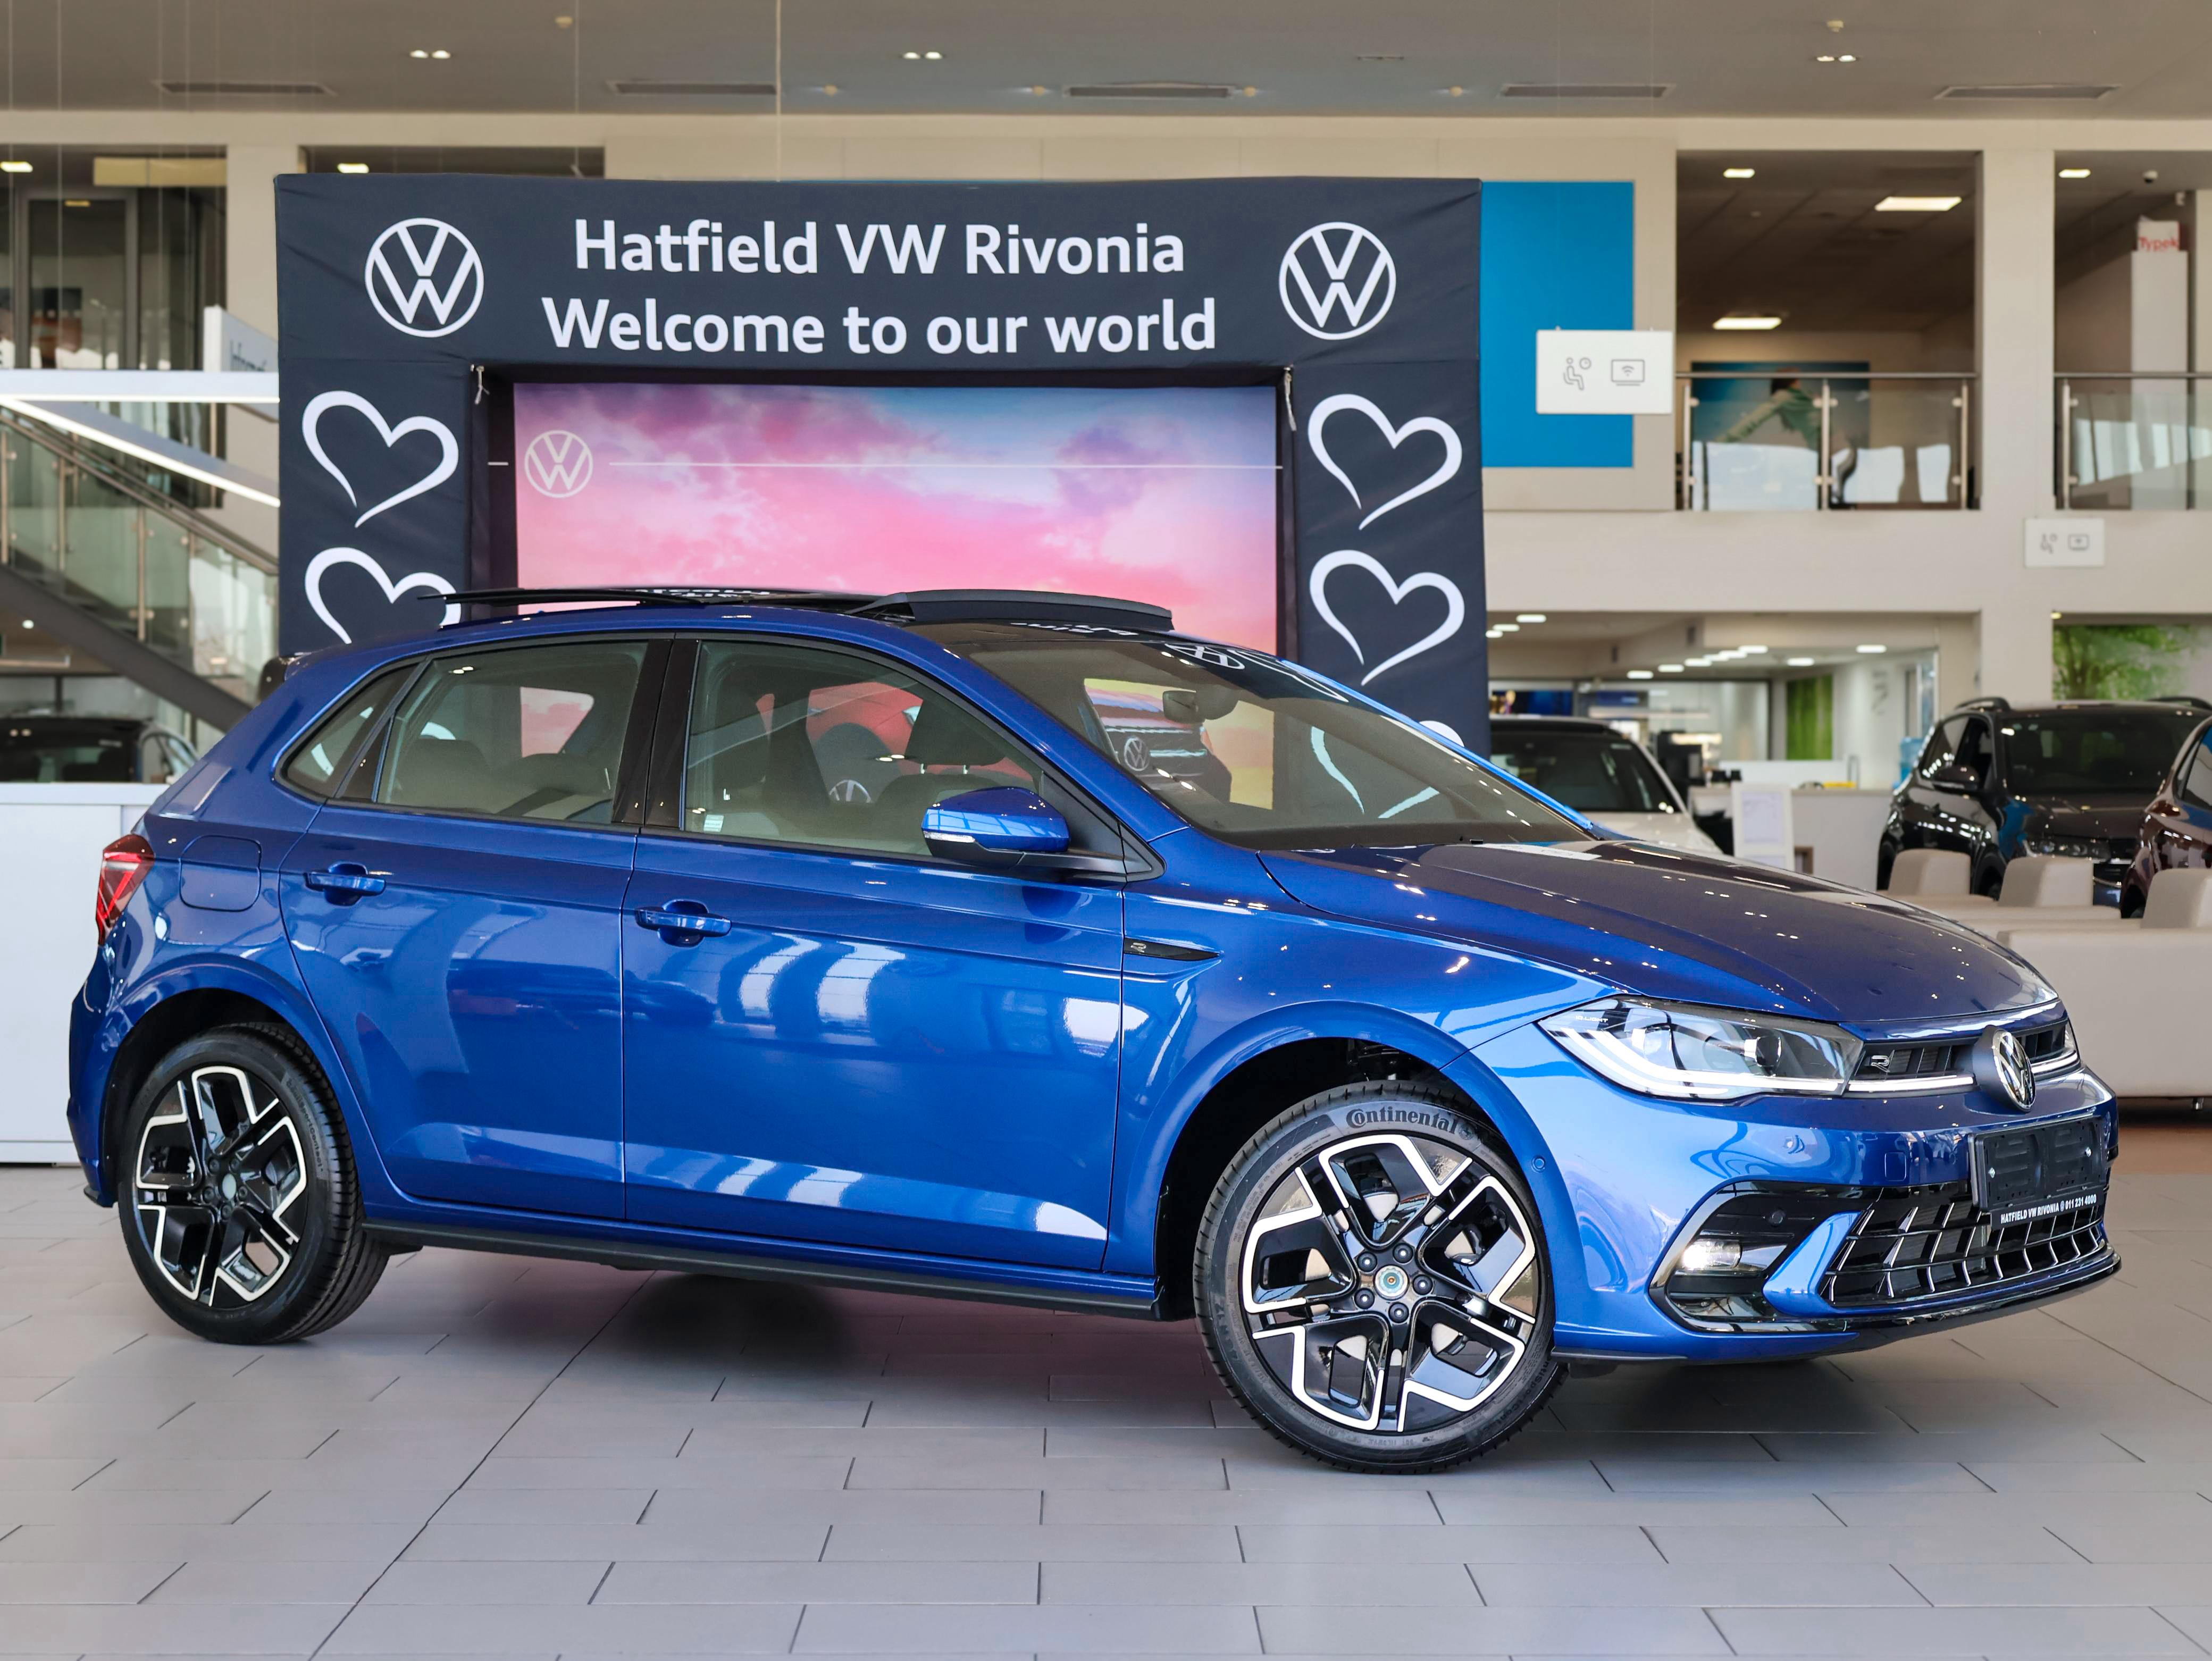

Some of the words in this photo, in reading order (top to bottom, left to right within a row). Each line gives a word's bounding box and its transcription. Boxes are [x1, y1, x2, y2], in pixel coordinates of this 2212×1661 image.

[576, 219, 817, 274] Hatfield
[836, 224, 946, 274] VW
[966, 223, 1184, 274] Rivonia
[541, 297, 825, 354] Welcome
[843, 307, 907, 354] to
[927, 316, 1028, 354] our
[1044, 297, 1215, 353] world
[1346, 1106, 1459, 1135] Continental
[2001, 1210, 2027, 1224] HATFIELD
[2028, 1207, 2037, 1218] VW
[2037, 1202, 2059, 1217] RIVONIA
[2065, 1198, 2074, 1210] 011
[2075, 1196, 2084, 1207] 231
[2084, 1194, 2097, 1205] 4000
